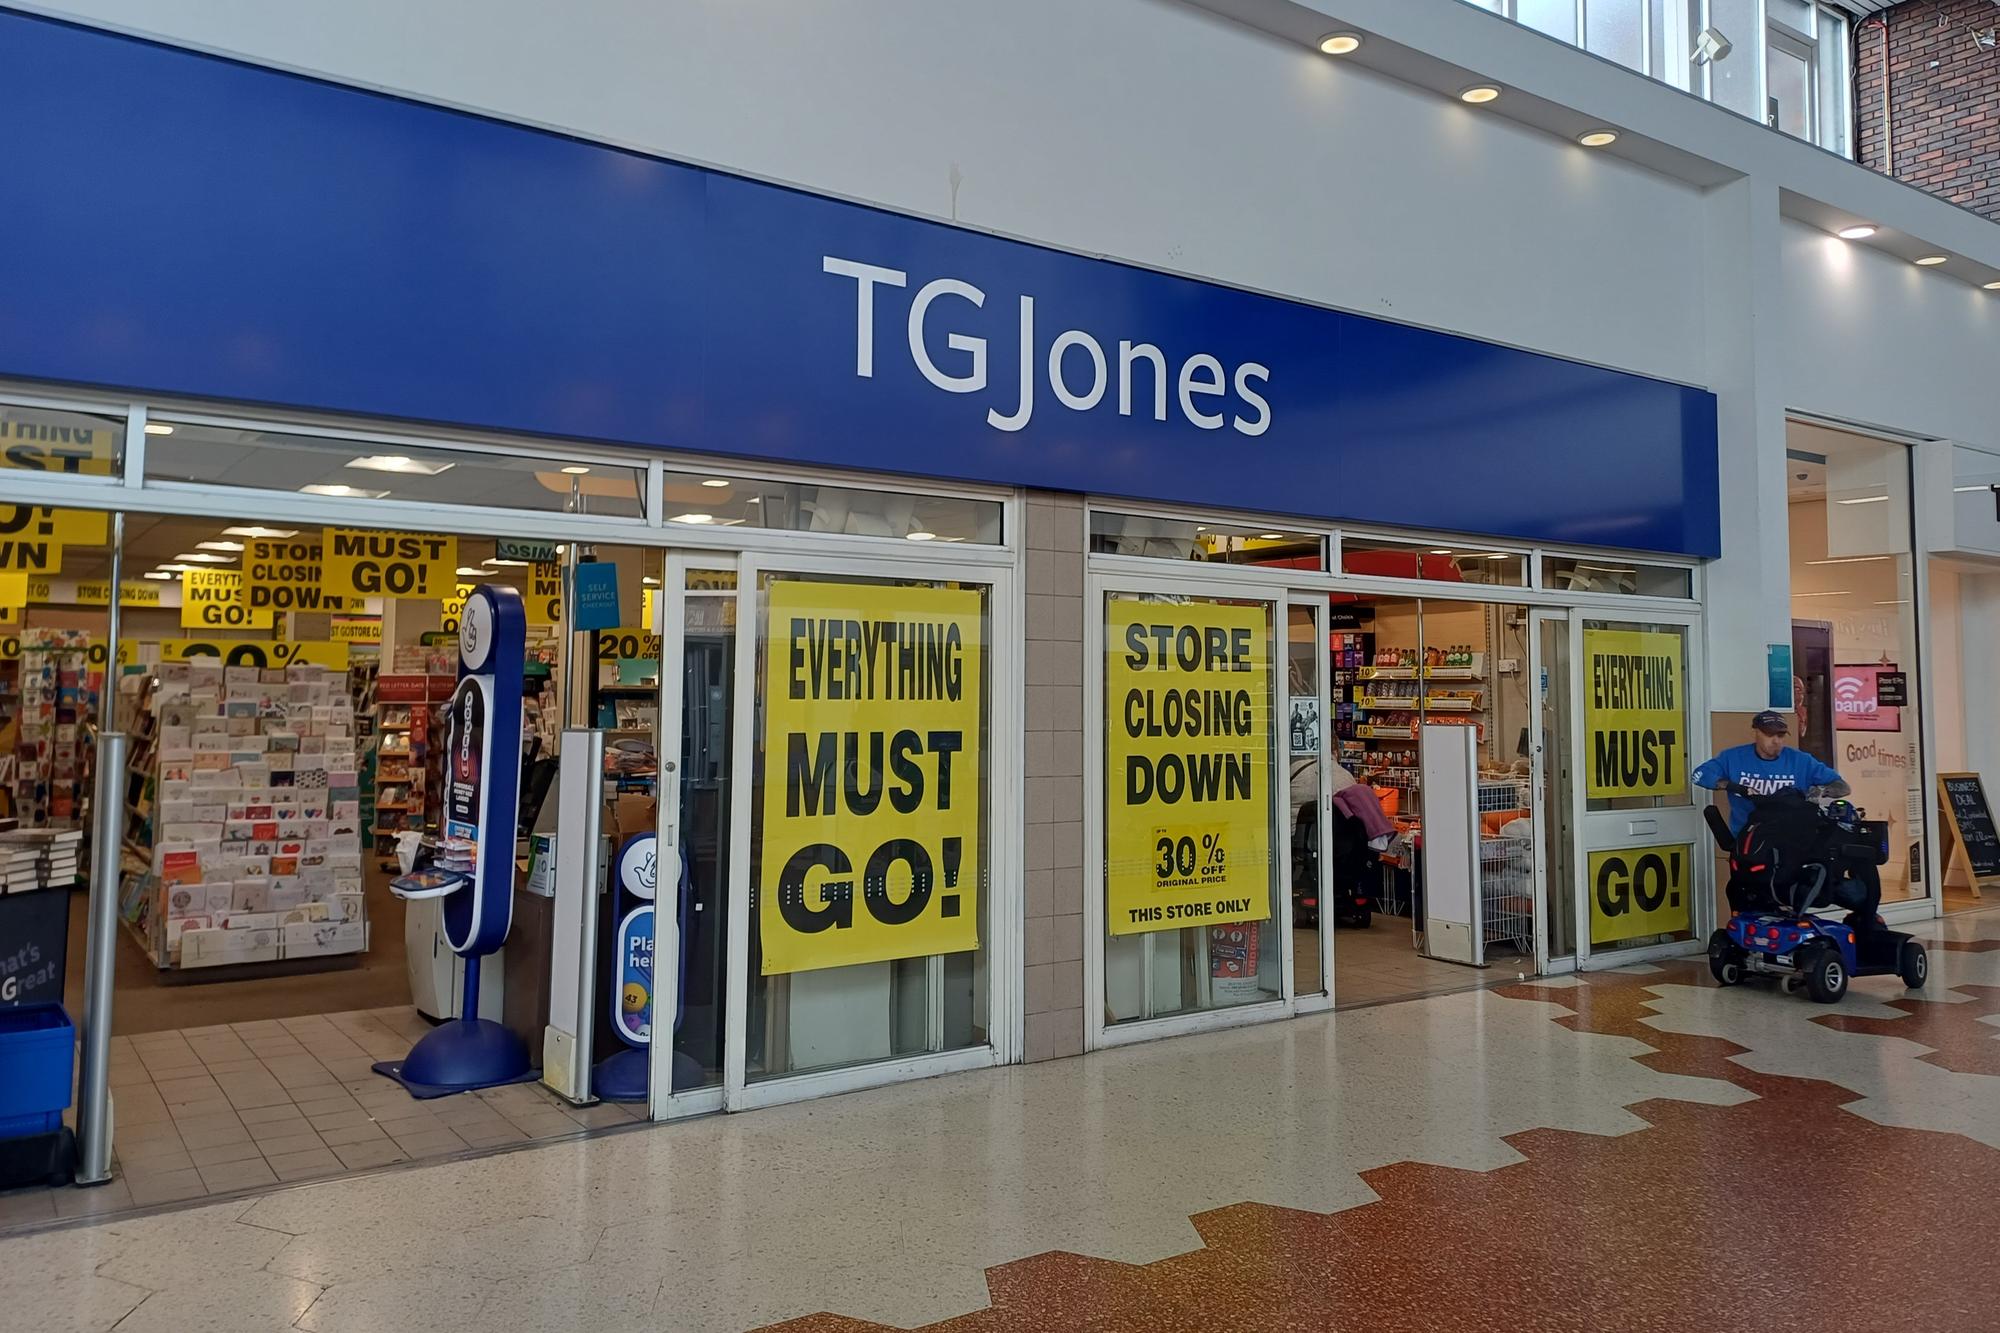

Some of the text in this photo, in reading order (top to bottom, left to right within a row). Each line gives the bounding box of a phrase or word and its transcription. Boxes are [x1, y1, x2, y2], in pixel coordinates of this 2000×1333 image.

[334, 535, 447, 560] MUST
[352, 561, 427, 594] GO!
[202, 605, 252, 625] GO!
[788, 617, 963, 702] EVERYTHING
[1125, 622, 1251, 673] STORE
[1593, 653, 1674, 711] EVERYTHING
[1125, 688, 1252, 738] CLOSING
[1595, 729, 1676, 788] MUST
[1846, 739, 1877, 763] Good
[1878, 748, 1907, 768] times
[786, 729, 963, 817] MUST
[1126, 752, 1251, 806] DOWN
[778, 836, 963, 933] GO!
[1156, 875, 1227, 888] ORIGINAL PRICE
[1201, 865, 1226, 875] OFF
[1596, 851, 1681, 918] GO!
[1129, 898, 1251, 922] THIS STORE ONLY
[625, 994, 638, 1003] 43
